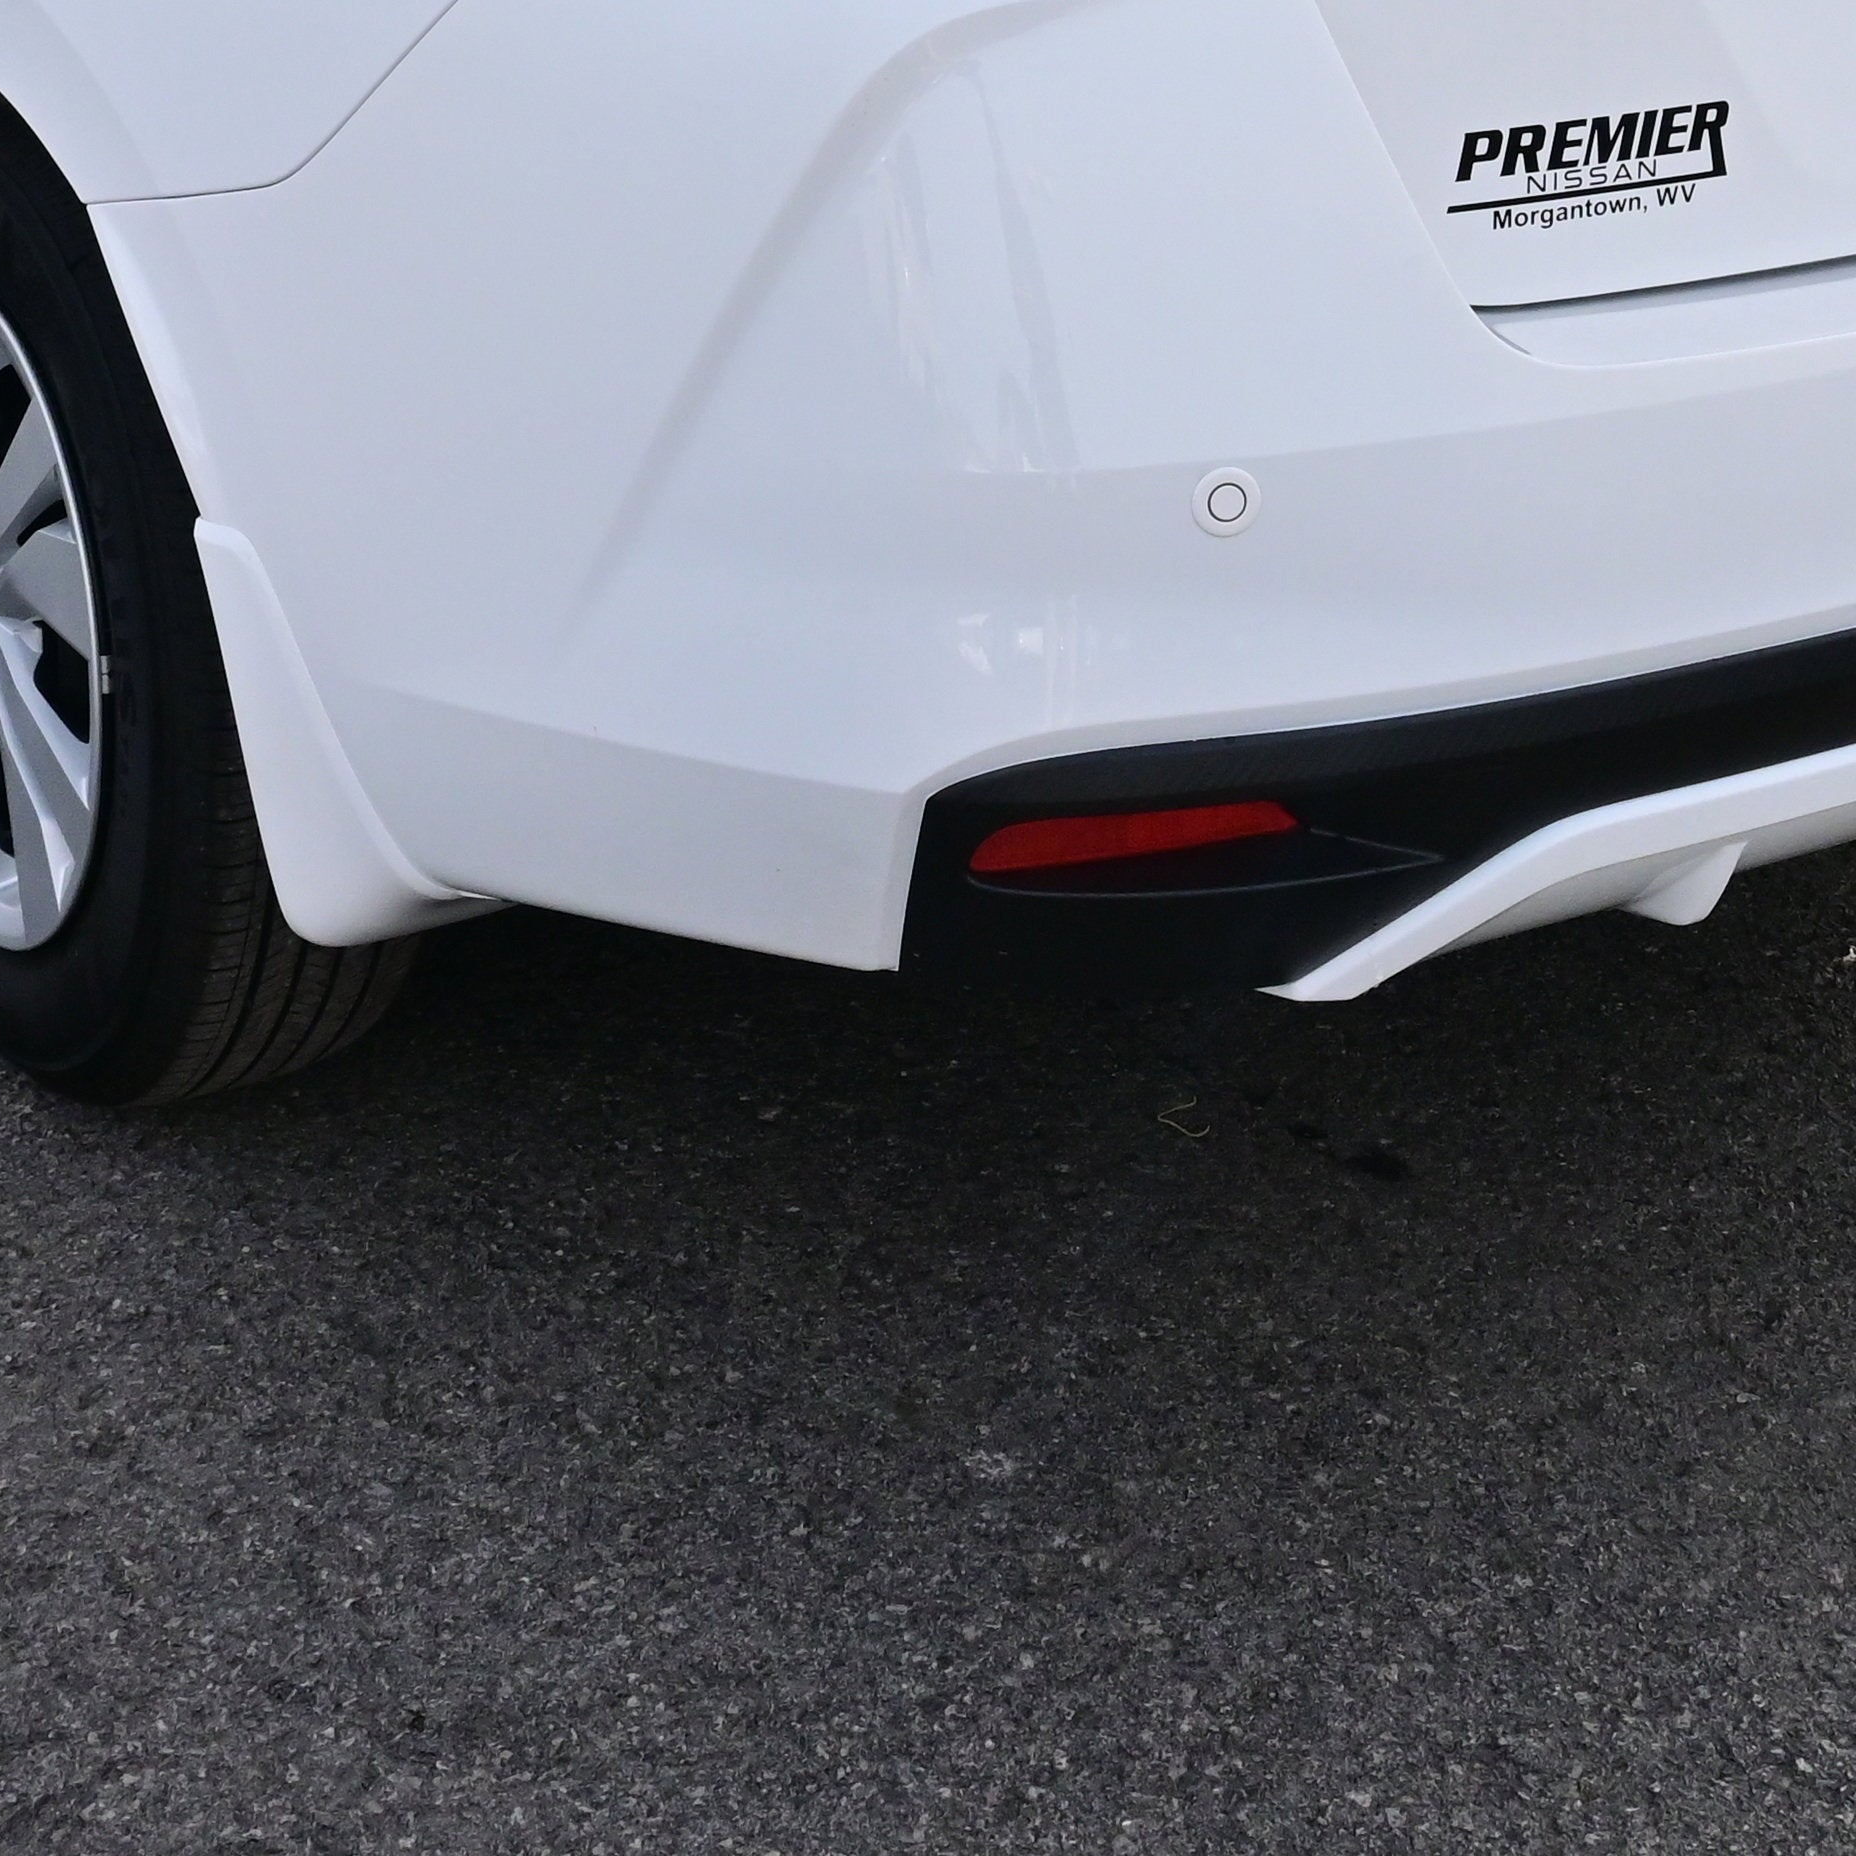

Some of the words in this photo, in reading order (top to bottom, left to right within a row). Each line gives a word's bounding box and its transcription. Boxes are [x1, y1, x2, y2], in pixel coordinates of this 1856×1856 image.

[1454, 100, 1730, 182] PREMIER
[1526, 159, 1657, 194] NISSAN
[1492, 195, 1648, 230] Morgantown,
[1656, 184, 1696, 207] WV
